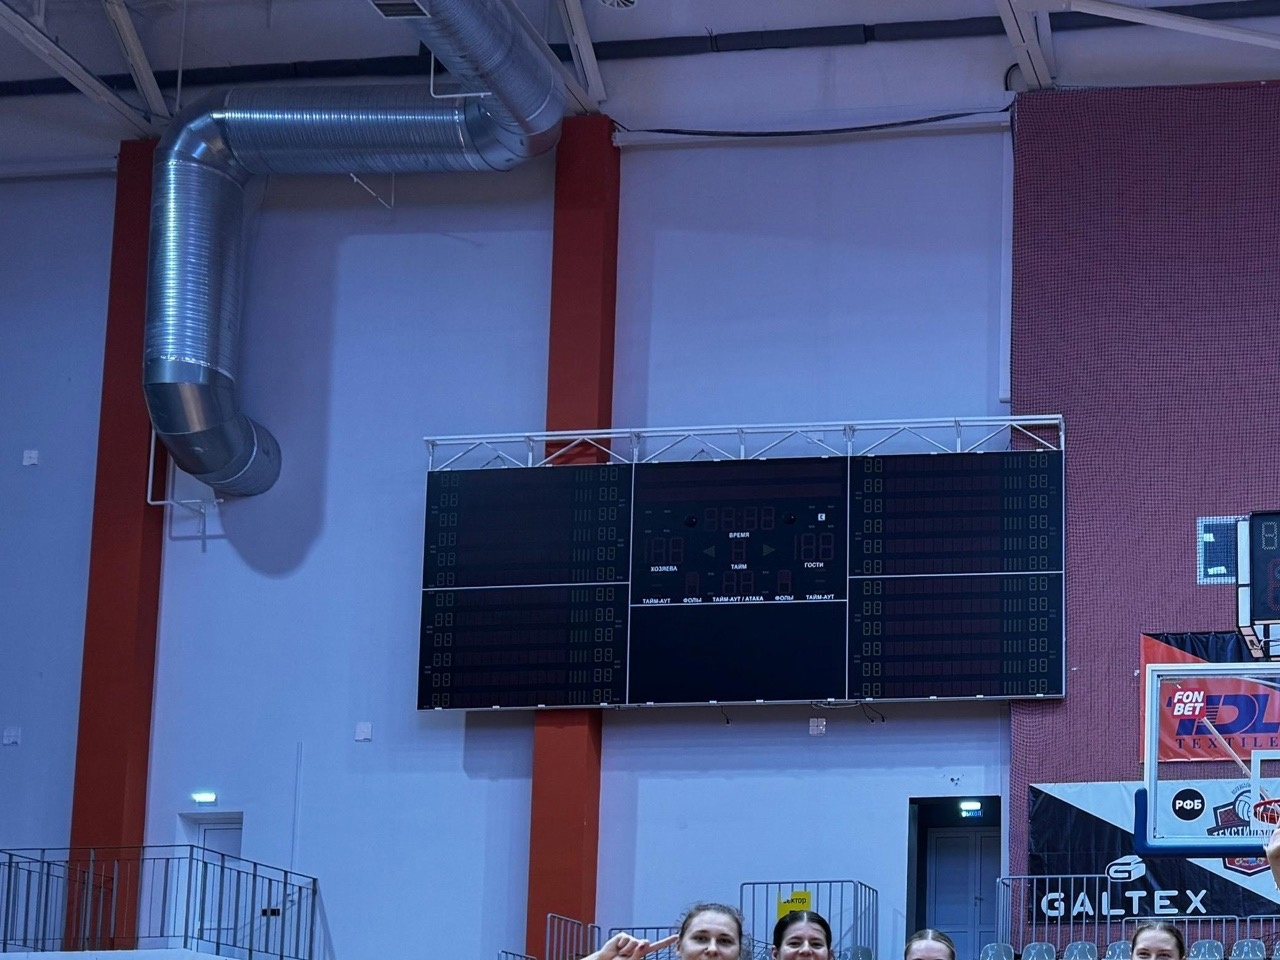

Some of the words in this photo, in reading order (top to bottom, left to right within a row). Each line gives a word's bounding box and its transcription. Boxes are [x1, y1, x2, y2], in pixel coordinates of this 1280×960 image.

[1174, 691, 1204, 703] FON
[1174, 703, 1204, 715] BET
[1176, 736, 1278, 749] TEXTILE
[1175, 799, 1202, 810] РФБ
[1041, 890, 1207, 916] GALTEX
